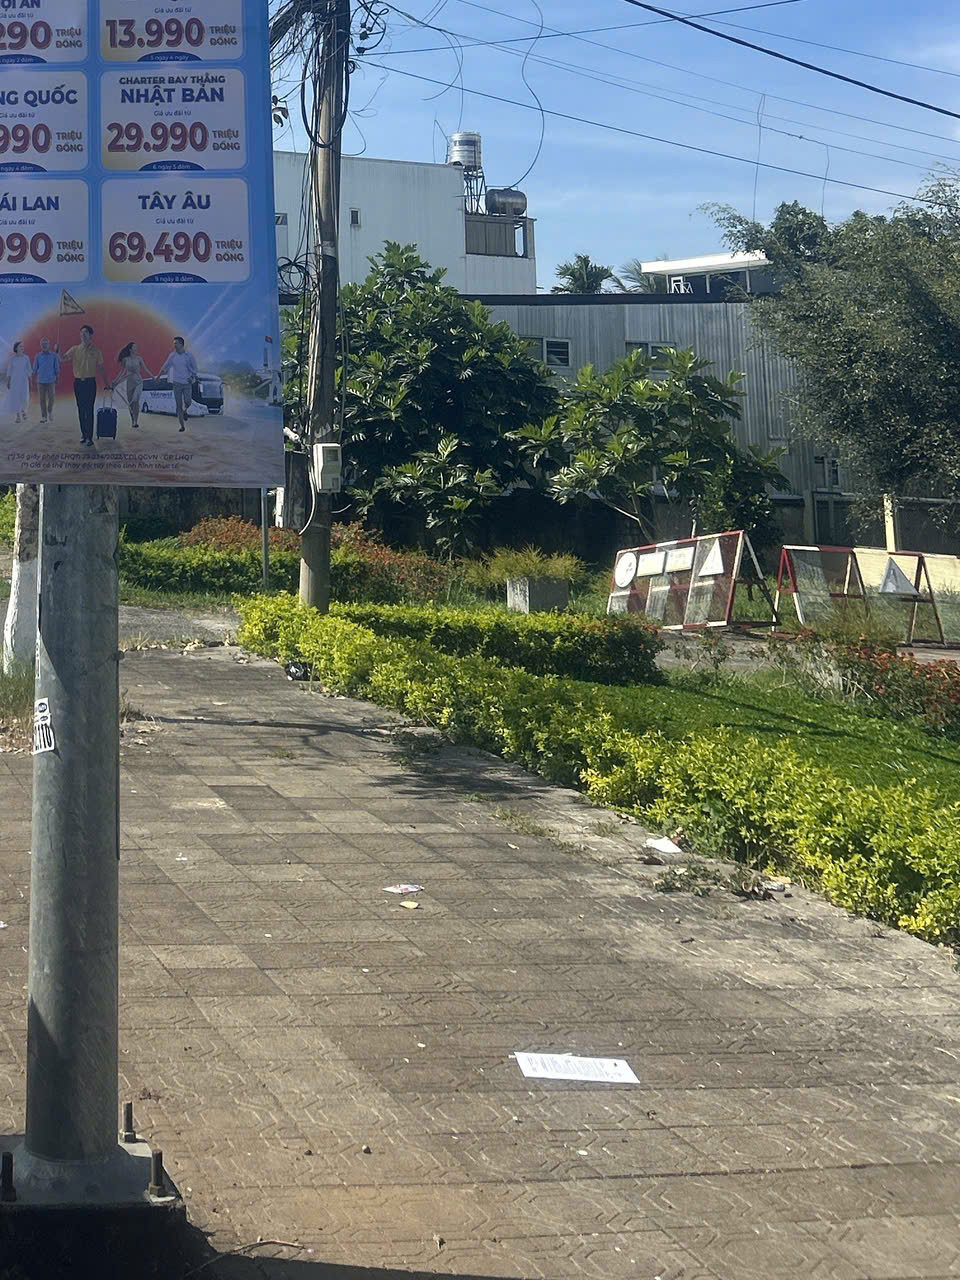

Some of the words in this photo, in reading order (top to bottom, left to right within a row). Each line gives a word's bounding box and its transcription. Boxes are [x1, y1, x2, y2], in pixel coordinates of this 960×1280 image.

[106, 18, 205, 48] 13.990
[119, 75, 165, 85] CHARTER
[168, 75, 188, 84] BAY
[24, 84, 79, 108] QUỐC
[121, 85, 176, 106] NHẬT
[181, 83, 225, 103] BẢN
[106, 121, 209, 152] 29.990
[22, 196, 60, 211] LAN
[138, 190, 177, 210] TÂY
[182, 190, 211, 210] ÂU
[109, 231, 212, 263] 69.490
